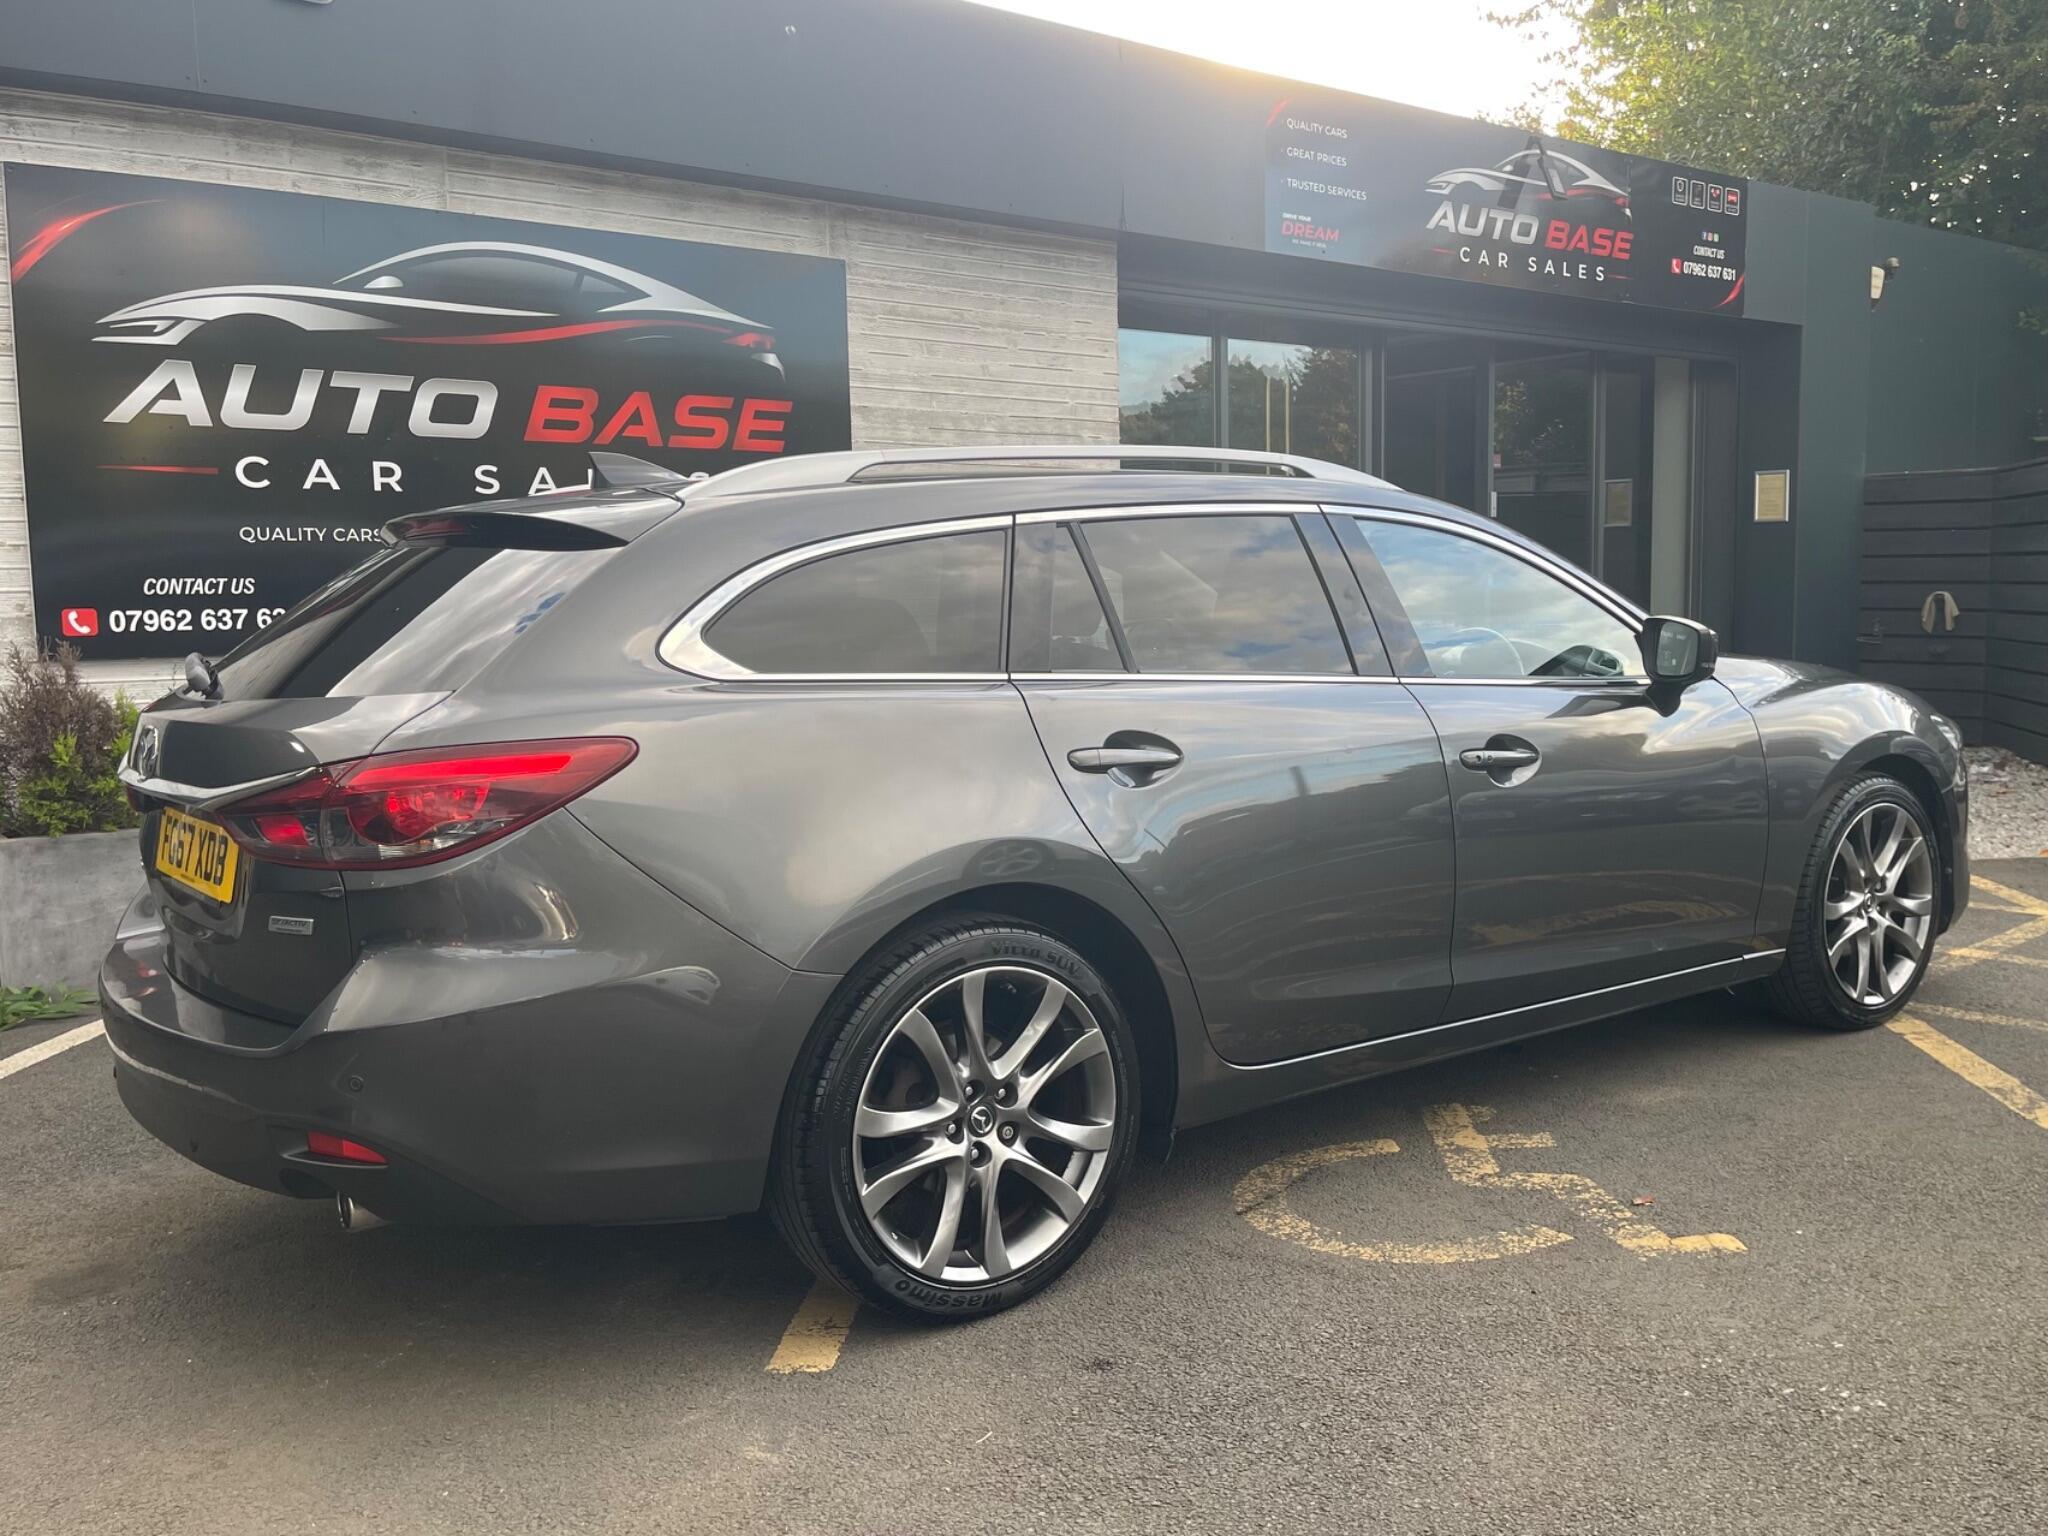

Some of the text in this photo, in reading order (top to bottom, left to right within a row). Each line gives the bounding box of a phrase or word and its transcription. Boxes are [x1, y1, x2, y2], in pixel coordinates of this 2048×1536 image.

[1286, 118, 1348, 139] QUALITY CARS
[1286, 147, 1348, 167] GREAT PRICES
[1287, 178, 1367, 201] TRUSTED SERVICES
[1281, 220, 1340, 241] DREAM
[1426, 200, 1634, 260] AUTO BASE
[1693, 245, 1726, 260] CONTACT US
[1459, 247, 1605, 281] CAR SALES
[1683, 261, 1736, 281] 07962 637 631
[103, 359, 793, 453] AUTO BASE
[235, 456, 403, 491] CAR
[239, 526, 381, 543] QUALITY CARS
[143, 577, 256, 595] CONTACT US
[109, 609, 193, 632] 07962
[200, 608, 248, 630] 637
[194, 827, 229, 887] XDB
